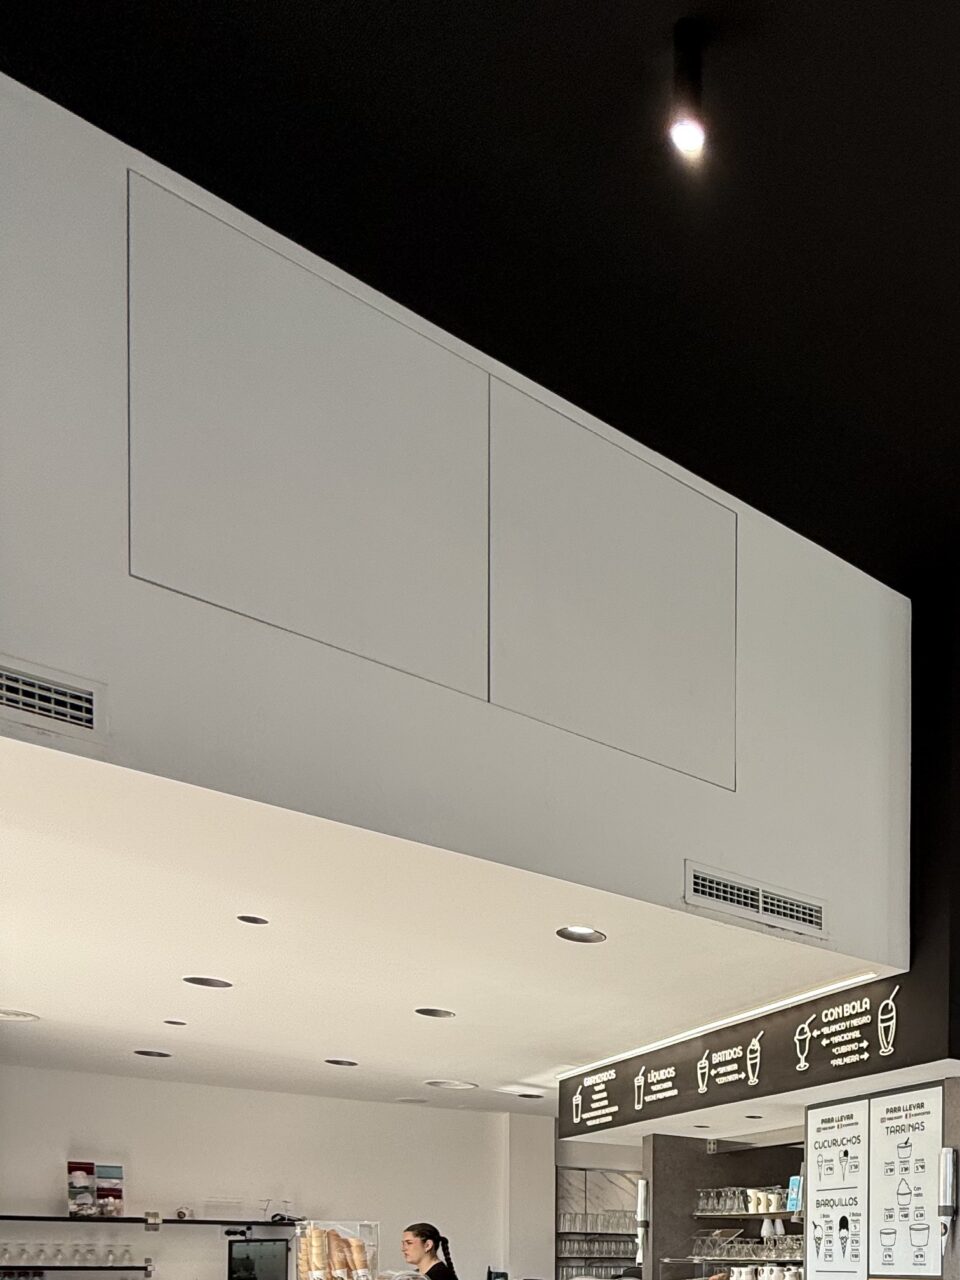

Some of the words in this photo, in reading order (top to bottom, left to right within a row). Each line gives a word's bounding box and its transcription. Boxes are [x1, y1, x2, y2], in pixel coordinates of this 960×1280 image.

[822, 1005, 842, 1022] CON
[844, 997, 870, 1017] BOLA
[846, 1020, 850, 1029] Y
[851, 1015, 871, 1027] NEGRO
[712, 1045, 743, 1064] BATIDOS
[647, 1066, 675, 1084] LÍQUIDOS
[886, 1105, 901, 1115] PARA
[902, 1102, 925, 1112] LLEVAR
[821, 1116, 834, 1125] PARA
[835, 1113, 854, 1123] LLEVAR
[885, 1121, 925, 1136] TARRINAS
[813, 1135, 861, 1150] CUCURUCHOS
[815, 1196, 859, 1209] BARQUILLOS
